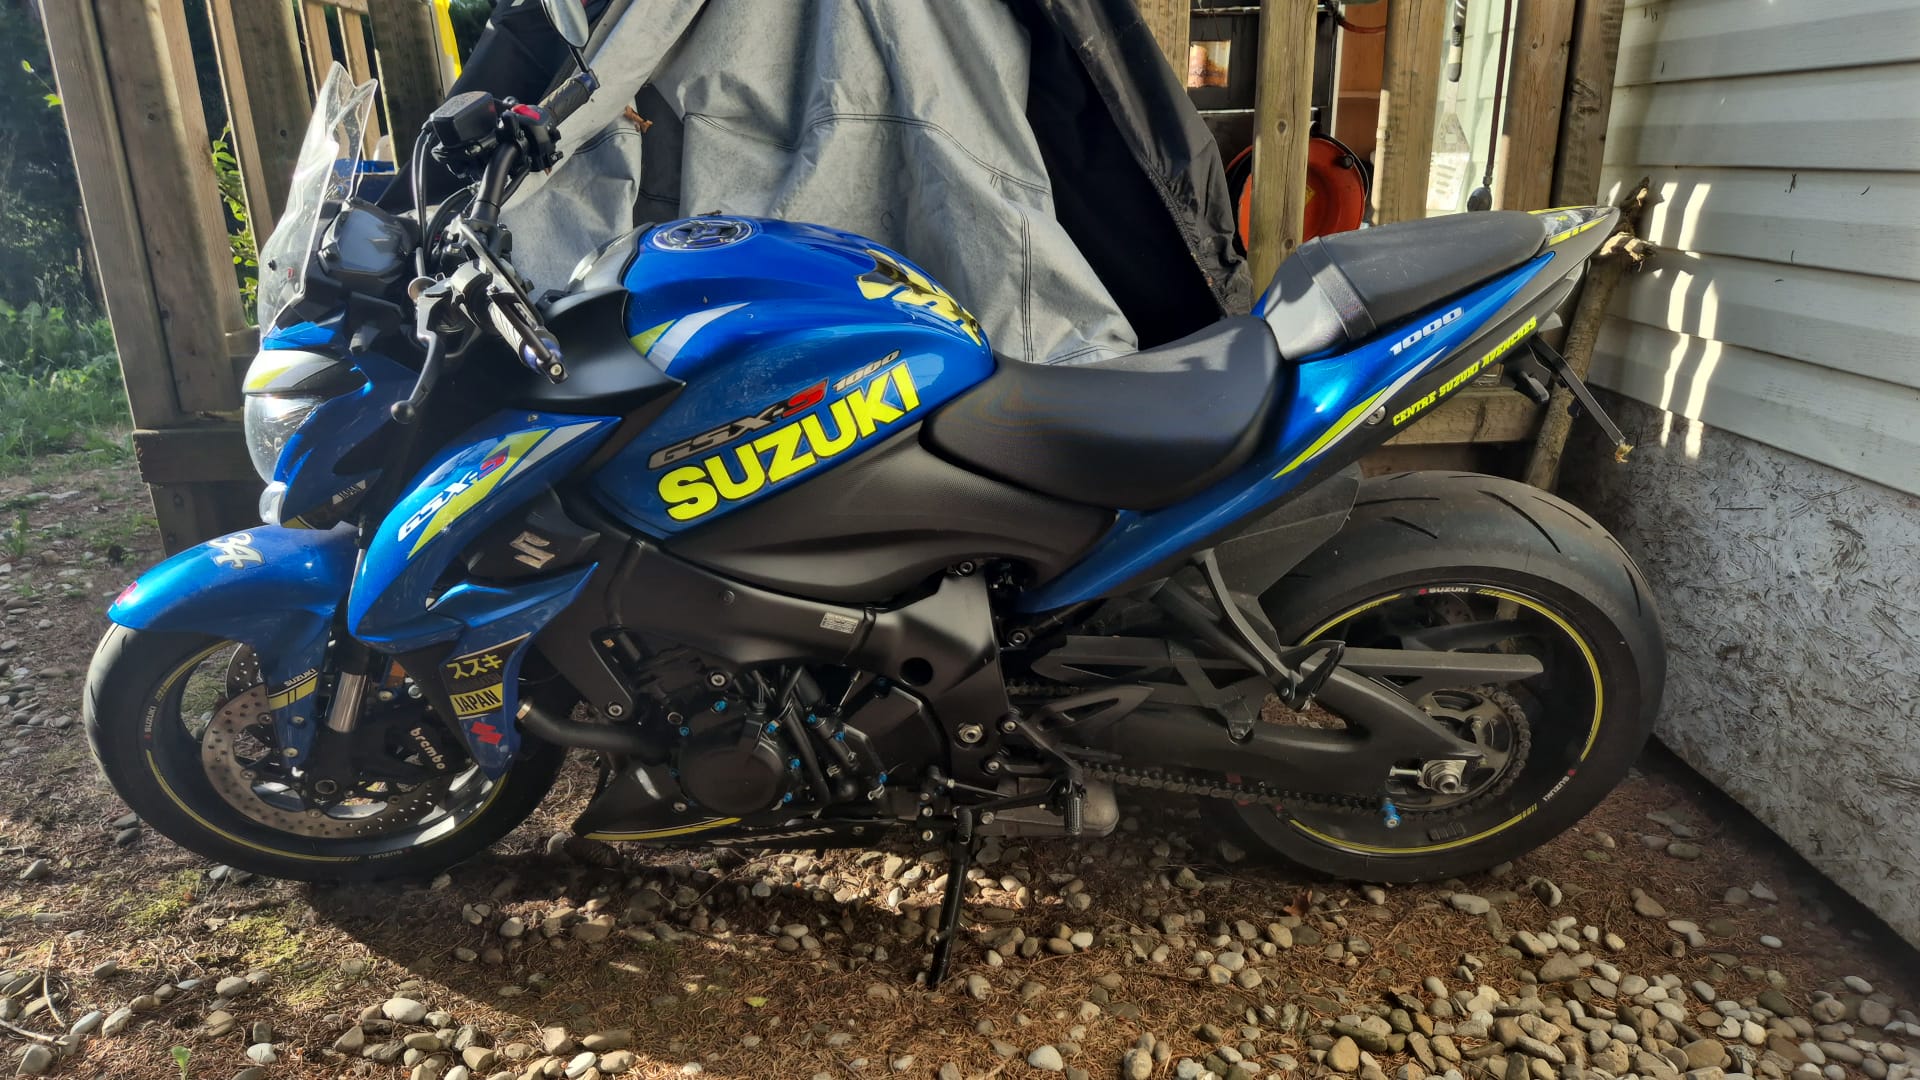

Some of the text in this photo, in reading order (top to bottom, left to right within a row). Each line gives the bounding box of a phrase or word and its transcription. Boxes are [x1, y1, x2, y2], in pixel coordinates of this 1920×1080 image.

[1390, 306, 1464, 356] 1000
[648, 349, 902, 470] GSX-S 1000
[1392, 390, 1438, 427] CENTRE
[1438, 361, 1481, 397] SUZUKI
[657, 359, 921, 522] SUZUKI
[397, 445, 510, 542] GSX-S
[454, 689, 502, 713] JAPAN
[409, 727, 446, 770] brembo
